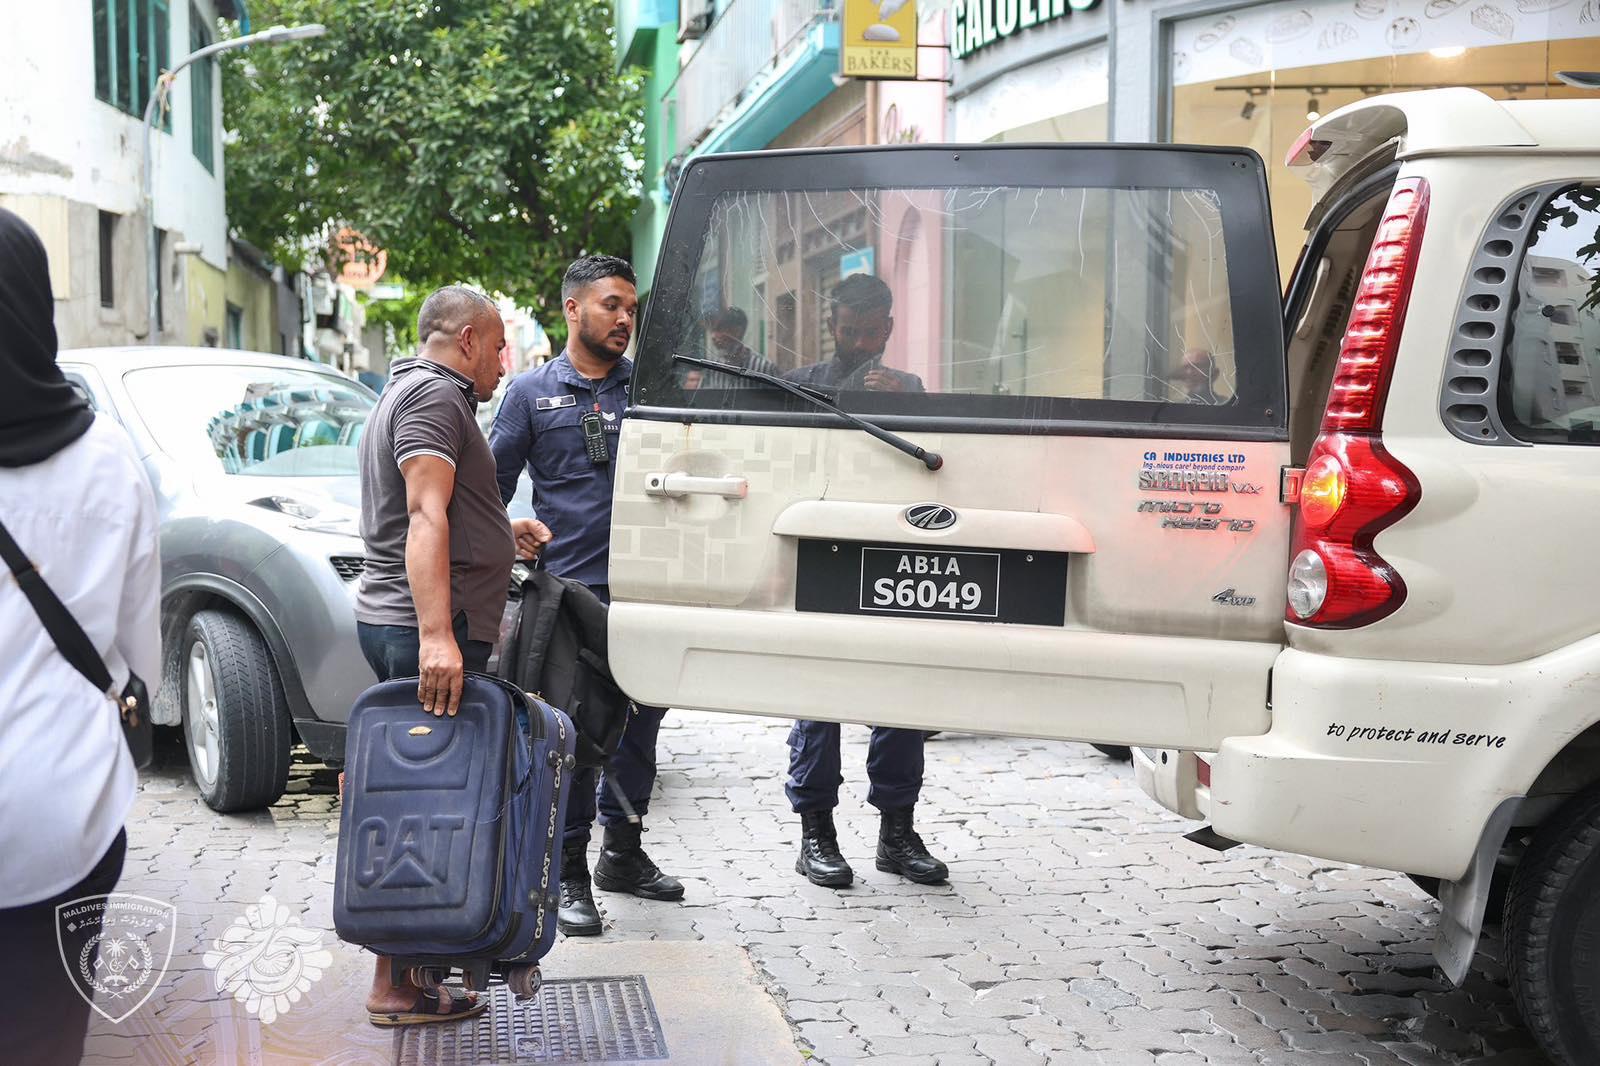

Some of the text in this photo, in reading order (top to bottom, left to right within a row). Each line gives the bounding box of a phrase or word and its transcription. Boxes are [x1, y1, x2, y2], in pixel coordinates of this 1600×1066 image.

[847, 56, 913, 73] BAKERS
[1164, 452, 1224, 463] INDUSTRIES
[1228, 454, 1246, 463] LTD
[1193, 464, 1216, 472] beyond
[1217, 465, 1246, 473] compare
[896, 555, 961, 576] AB1A
[873, 578, 982, 610] S6049
[1326, 722, 1506, 748] to protect and serve
[355, 814, 466, 889] CAT
